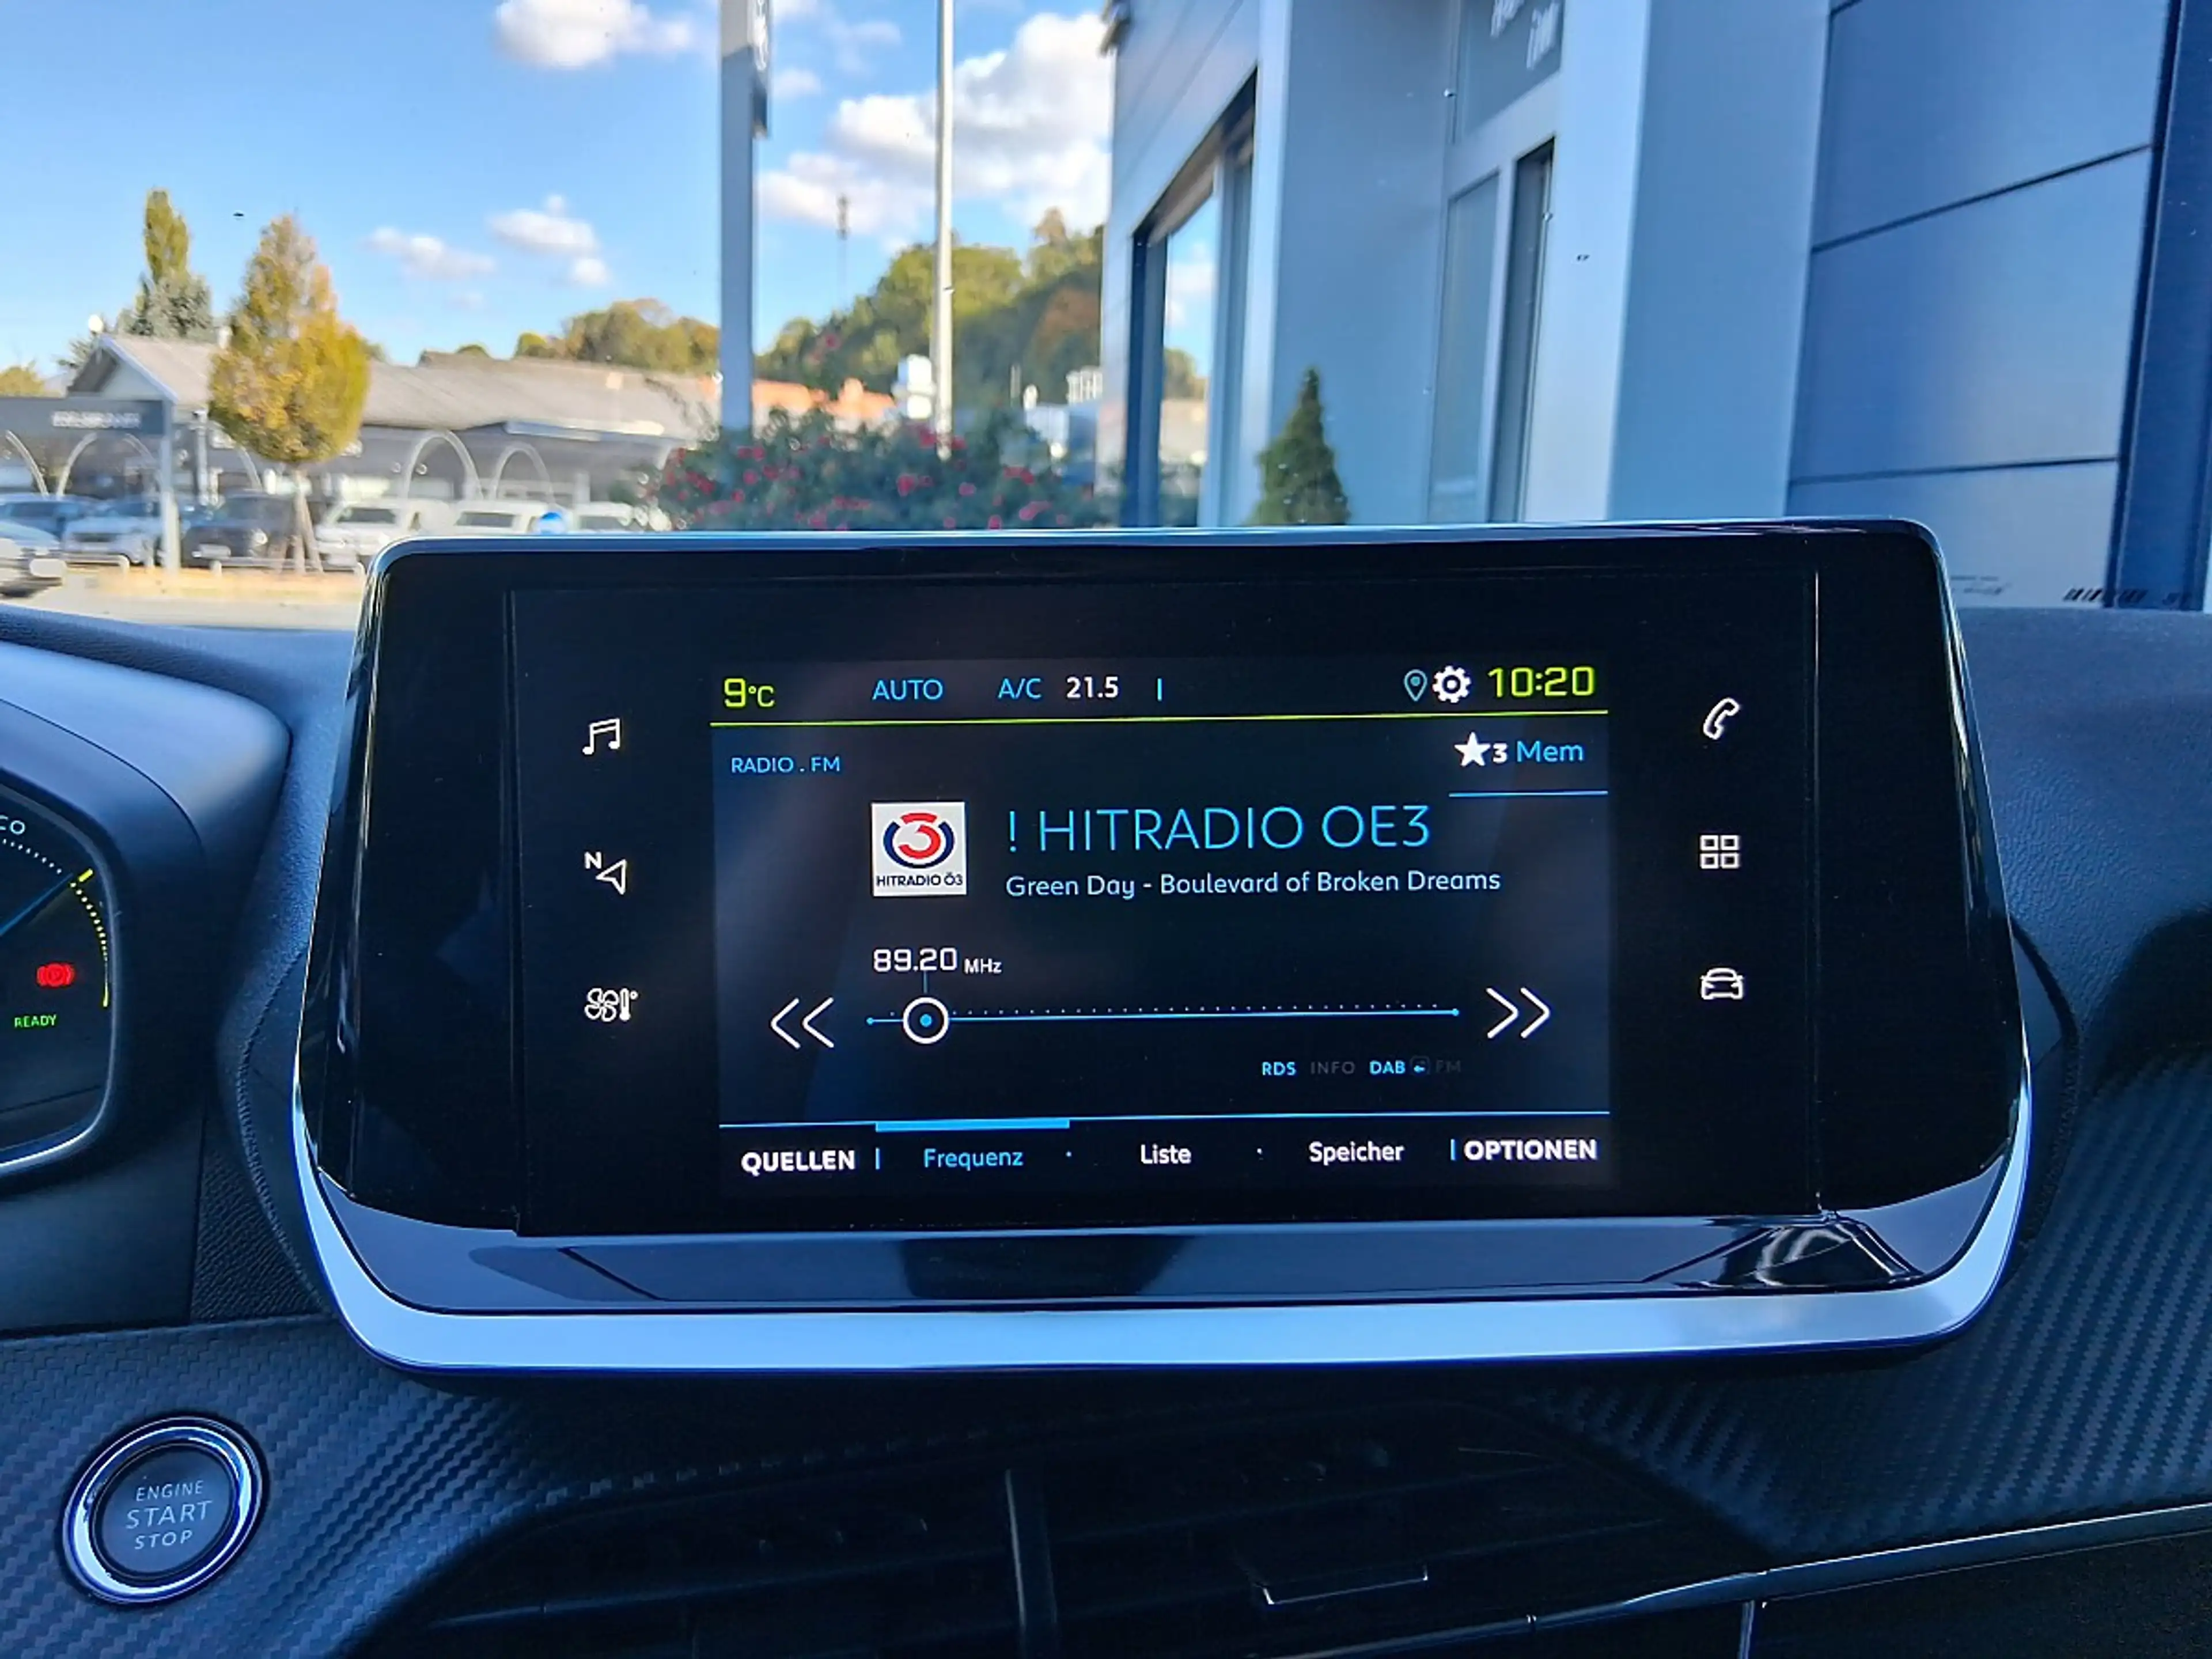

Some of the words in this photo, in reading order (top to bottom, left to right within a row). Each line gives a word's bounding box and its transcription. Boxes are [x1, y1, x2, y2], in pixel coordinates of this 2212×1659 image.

[872, 679, 944, 700] AUTO
[998, 678, 1041, 699] A/C
[1067, 676, 1119, 698] 21.5
[1488, 666, 1594, 698] 10:20
[1493, 743, 1508, 763] 3
[1517, 740, 1584, 762] Mem
[731, 757, 794, 773] RADIO
[810, 756, 840, 772] FM
[1039, 806, 1304, 851] HITRADIO
[1321, 805, 1430, 849] OE3
[876, 874, 941, 886] HITRADIO
[944, 870, 964, 886] Ö3
[1006, 876, 1079, 897] Green
[1087, 875, 1135, 900] Day
[1160, 871, 1278, 894] Boulevard
[1286, 870, 1310, 892] of
[1317, 870, 1400, 892] Broken
[1407, 870, 1501, 891] Dreams
[873, 948, 958, 972] 89.20
[964, 958, 1002, 975] MHz
[14, 1014, 57, 1028] READY
[1262, 1061, 1297, 1076] RDS
[1310, 1061, 1355, 1075] INFO
[1369, 1060, 1406, 1075] DAB
[924, 1148, 1024, 1171] Frequenz
[1141, 1143, 1192, 1165] Liste
[1309, 1141, 1404, 1166] Speicher
[1464, 1138, 1598, 1161] OPTIONEN
[741, 1150, 856, 1177] QUELLEN
[135, 1480, 204, 1502] ENGINE
[126, 1500, 213, 1529] START
[134, 1529, 193, 1550] STOP
